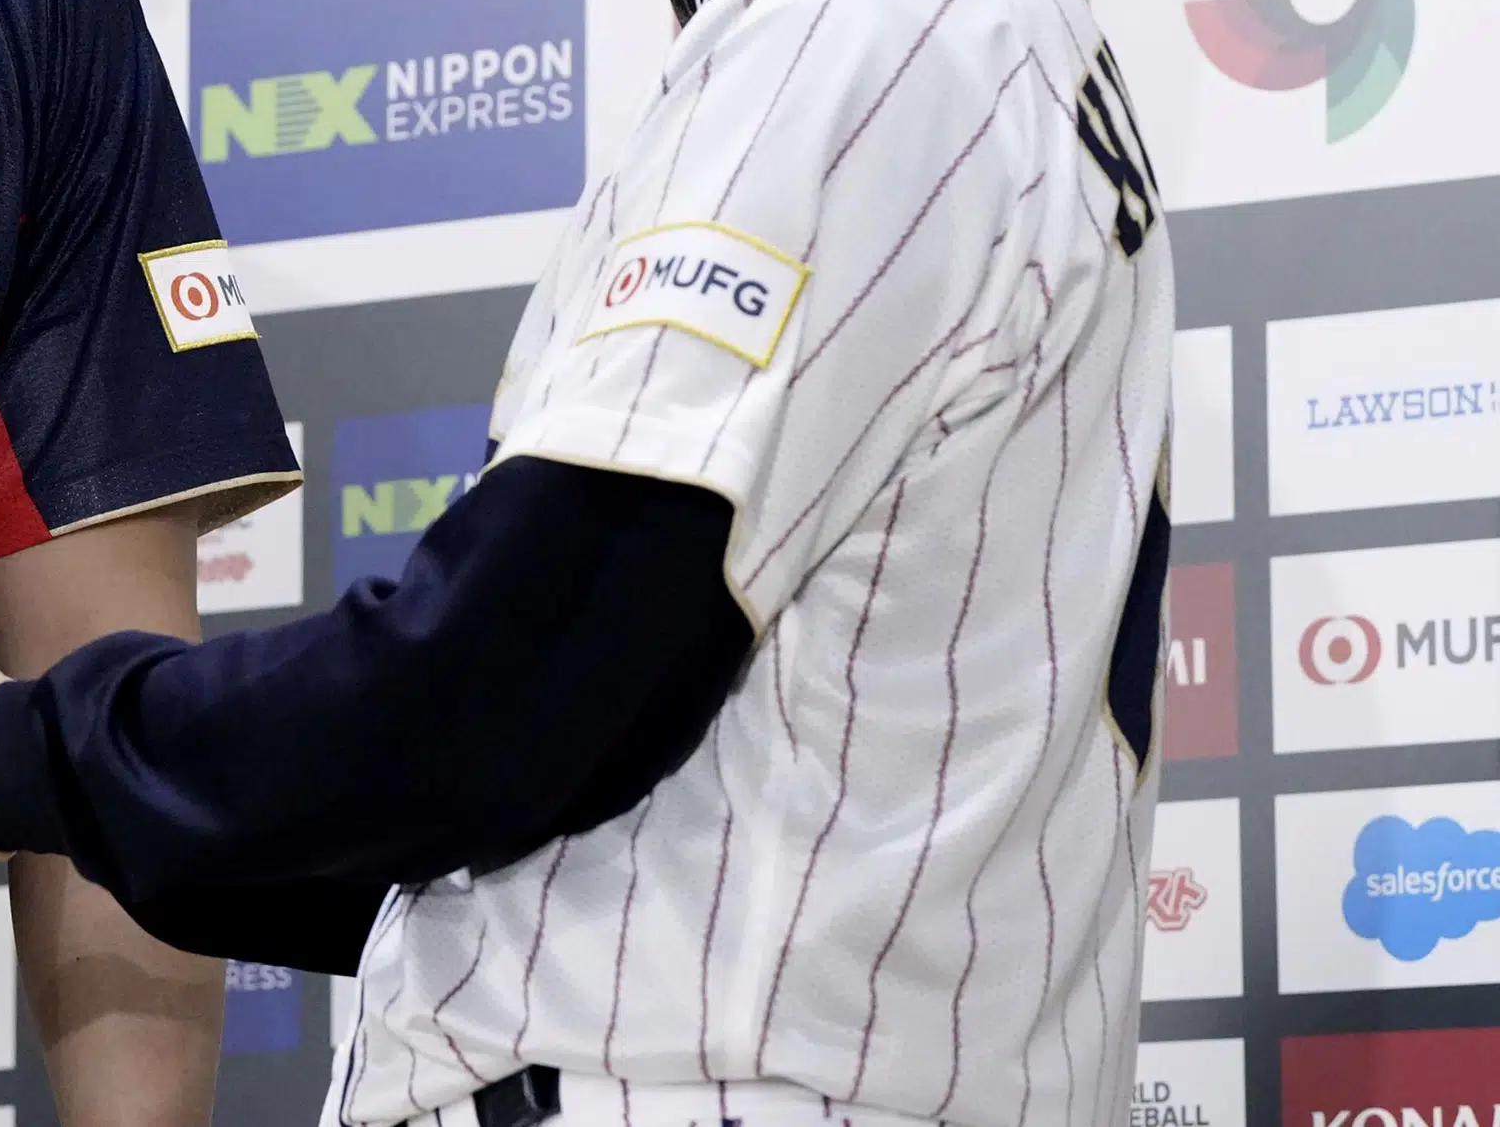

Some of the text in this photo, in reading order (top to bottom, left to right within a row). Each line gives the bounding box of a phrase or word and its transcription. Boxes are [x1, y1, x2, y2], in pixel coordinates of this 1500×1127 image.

[386, 38, 572, 100] NIPPON
[386, 82, 572, 142] EXPRESS
[646, 255, 768, 316] MUFG
[1307, 382, 1484, 430] LAWSON
[1133, 1081, 1171, 1104] LD
